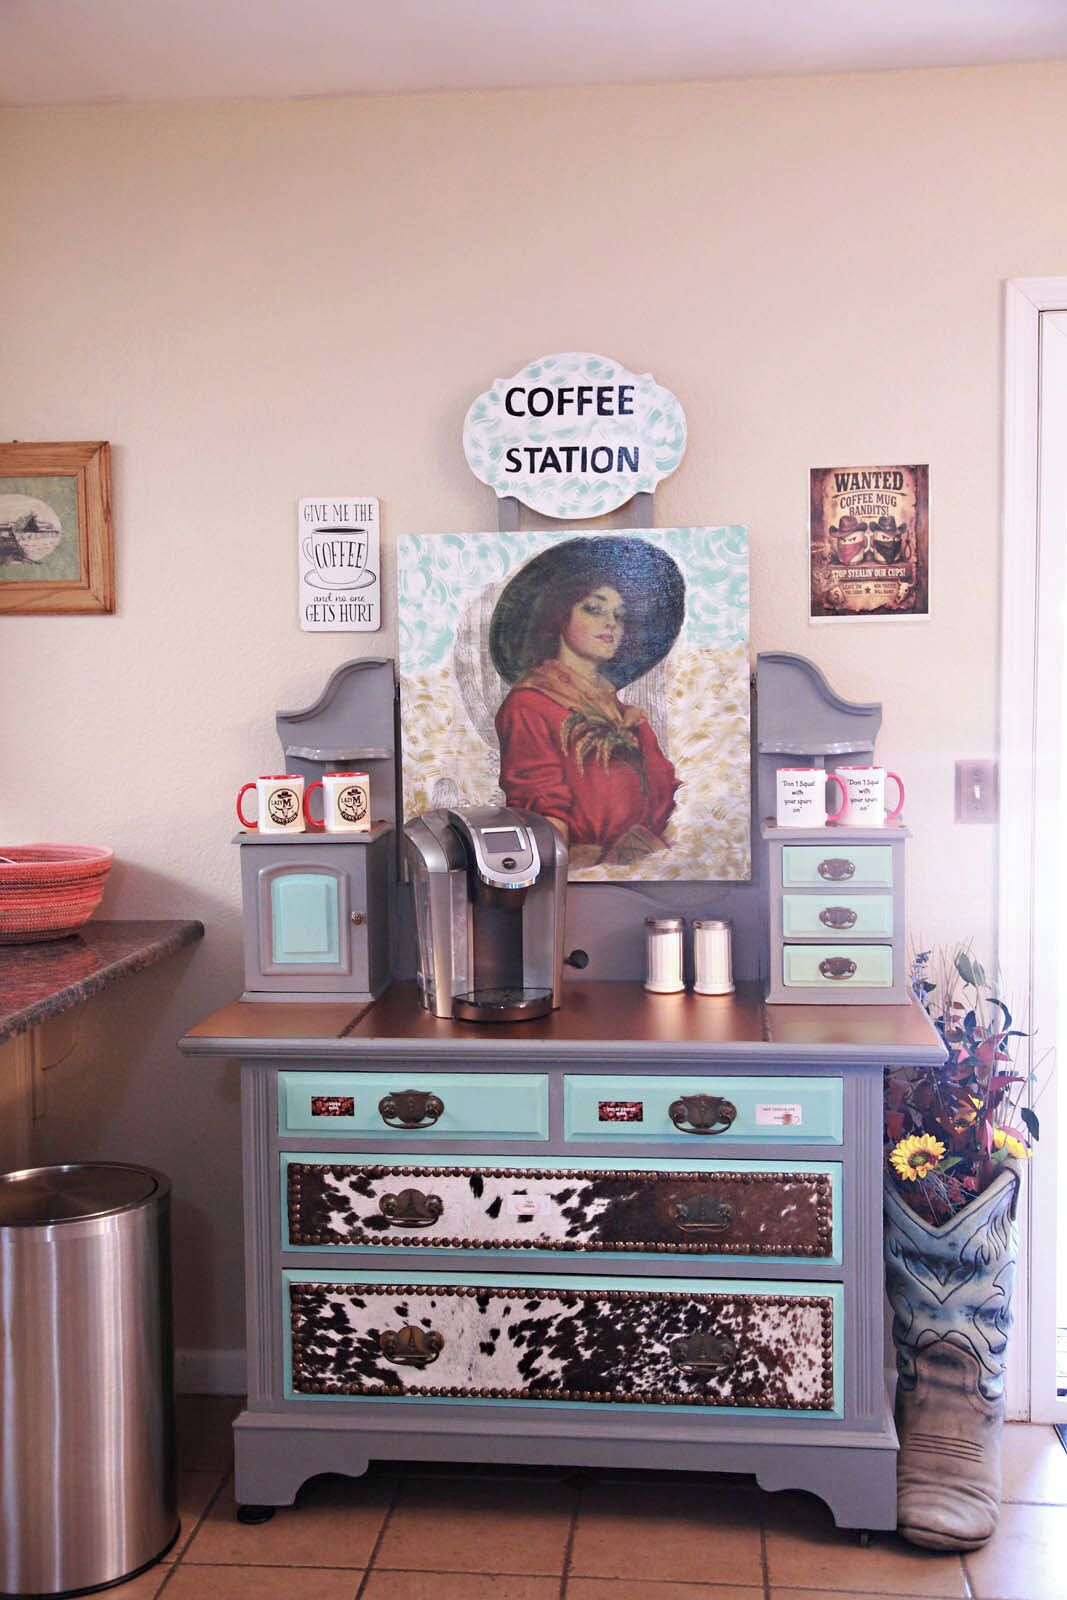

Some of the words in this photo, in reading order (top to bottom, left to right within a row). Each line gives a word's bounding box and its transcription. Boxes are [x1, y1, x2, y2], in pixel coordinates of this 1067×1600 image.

[505, 385, 635, 417] COFFEE
[505, 446, 640, 474] STATION
[834, 471, 904, 493] WANTED
[840, 493, 873, 509] COFFEE
[876, 494, 897, 507] MUG
[304, 504, 328, 522] GIVE
[333, 504, 349, 522] ME
[353, 504, 374, 522] THE
[849, 504, 889, 517] BANDITS!
[315, 541, 366, 569] COFFEE
[831, 569, 847, 578] STOP
[874, 568, 887, 577] OUR
[887, 567, 906, 577] CUPS!
[313, 592, 332, 603] and
[335, 595, 347, 603] no
[349, 595, 366, 603] one
[305, 604, 335, 623] GETS
[339, 604, 374, 622] HURT
[283, 798, 291, 808] M
[352, 795, 361, 805] M
